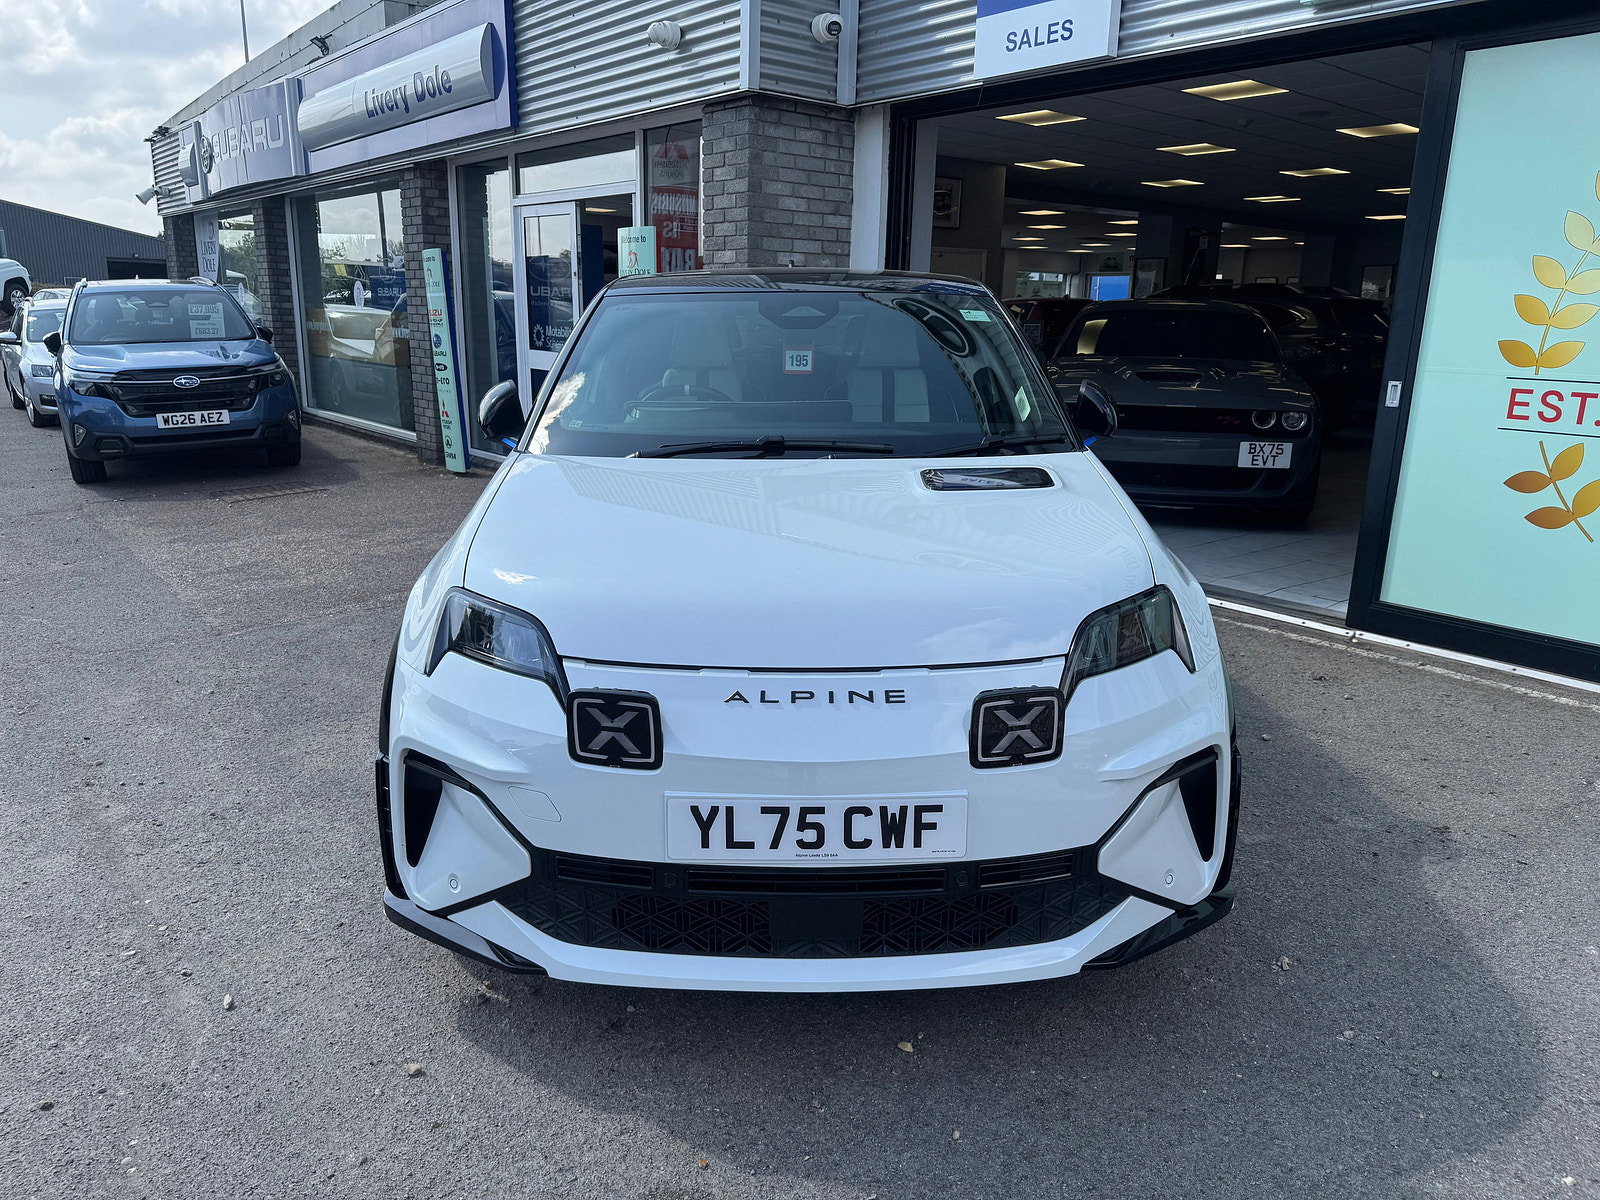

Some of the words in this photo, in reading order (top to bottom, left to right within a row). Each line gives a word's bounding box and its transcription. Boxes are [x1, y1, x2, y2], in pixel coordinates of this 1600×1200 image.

[1006, 19, 1074, 52] SALES
[364, 83, 410, 118] Livery
[413, 65, 453, 103] Dole
[212, 114, 284, 164] SUBARU
[789, 354, 809, 367] 195
[162, 414, 196, 426] WG26
[200, 412, 224, 424] AEZ
[1248, 443, 1284, 455] BX75
[1251, 455, 1279, 467] EVT
[724, 690, 906, 704] ALPINE
[690, 805, 826, 850] YL75
[843, 804, 944, 850] CWF
